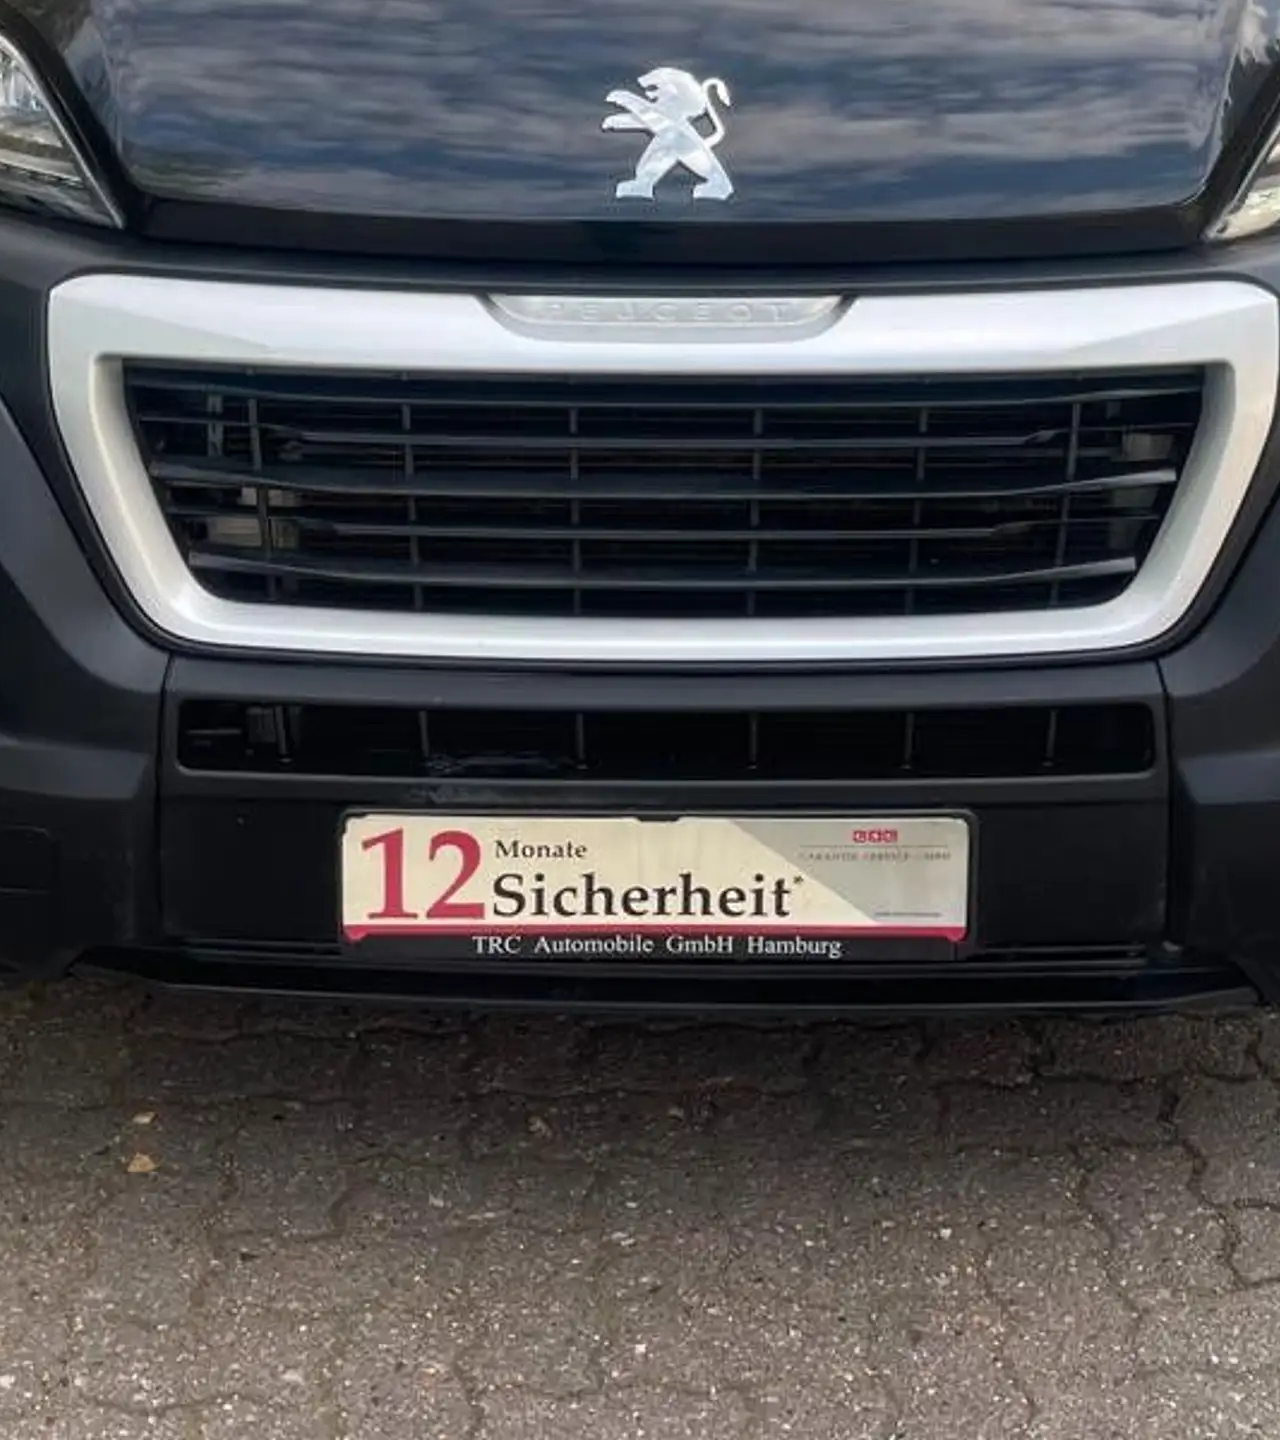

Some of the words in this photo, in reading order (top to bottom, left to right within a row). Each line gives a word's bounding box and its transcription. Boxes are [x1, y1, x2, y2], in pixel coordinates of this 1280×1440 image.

[494, 839, 588, 859] Monate
[361, 826, 485, 920] 12
[472, 935, 521, 954] TRC
[534, 935, 654, 954] Automobile
[666, 935, 733, 954] GmbH
[747, 935, 843, 959] Hamburg
